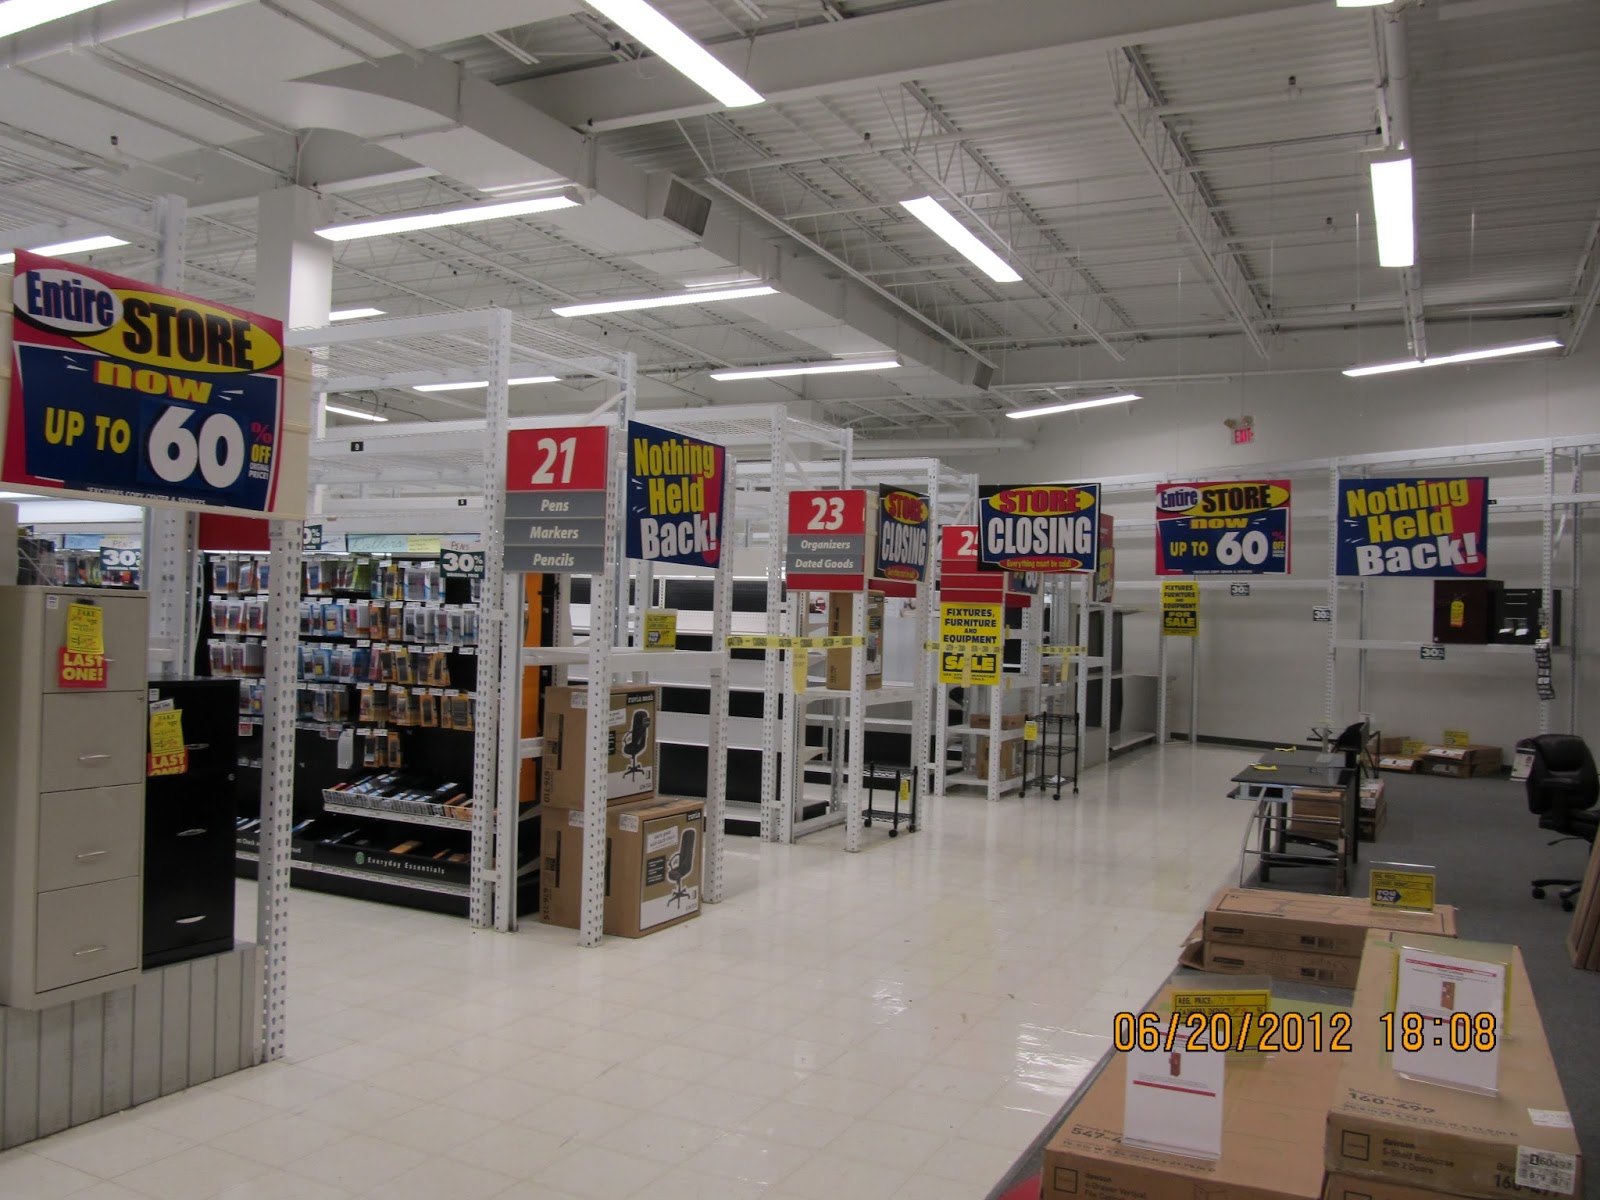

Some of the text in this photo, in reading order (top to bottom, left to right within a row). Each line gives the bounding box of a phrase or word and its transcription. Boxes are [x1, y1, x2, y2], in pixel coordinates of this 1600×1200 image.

[26, 271, 254, 370] Entire STORE
[94, 360, 213, 404] now
[44, 405, 245, 488] UP TO 60
[251, 444, 271, 464] OFF
[531, 437, 577, 485] 21
[633, 438, 715, 479] Nothing
[540, 499, 569, 512] Pens
[648, 477, 705, 516] Held
[999, 490, 1081, 513] STORE
[1161, 485, 1271, 513] Entire STORE
[1346, 479, 1470, 517] Nothing
[807, 497, 845, 530] 23
[888, 491, 924, 523] STORE
[1190, 518, 1248, 529] now
[1367, 506, 1454, 543] Held
[530, 527, 579, 540] Markers
[640, 511, 718, 560] Back!
[881, 520, 927, 566] CLOSING
[988, 516, 1092, 554] CLOSING
[801, 540, 850, 551] Organizers
[1170, 530, 1269, 565] UP TO 60
[1356, 532, 1479, 576] Back!
[102, 549, 136, 566] 30
[442, 553, 474, 572] 30
[533, 553, 575, 566] Pencils
[795, 559, 854, 569] Dated Goods
[1006, 560, 1035, 569] Everything
[1051, 560, 1058, 568] be
[944, 619, 997, 627] FURNITURE
[946, 609, 995, 618] FIXTURES,
[1165, 618, 1195, 627] SALE
[943, 635, 997, 643] EQUIPMENT
[64, 653, 103, 667] LAST
[62, 667, 103, 681] ONE!
[152, 752, 185, 769] LAST
[367, 856, 445, 875] Everyday Essentials
[1071, 1127, 1121, 1144] 547-4
